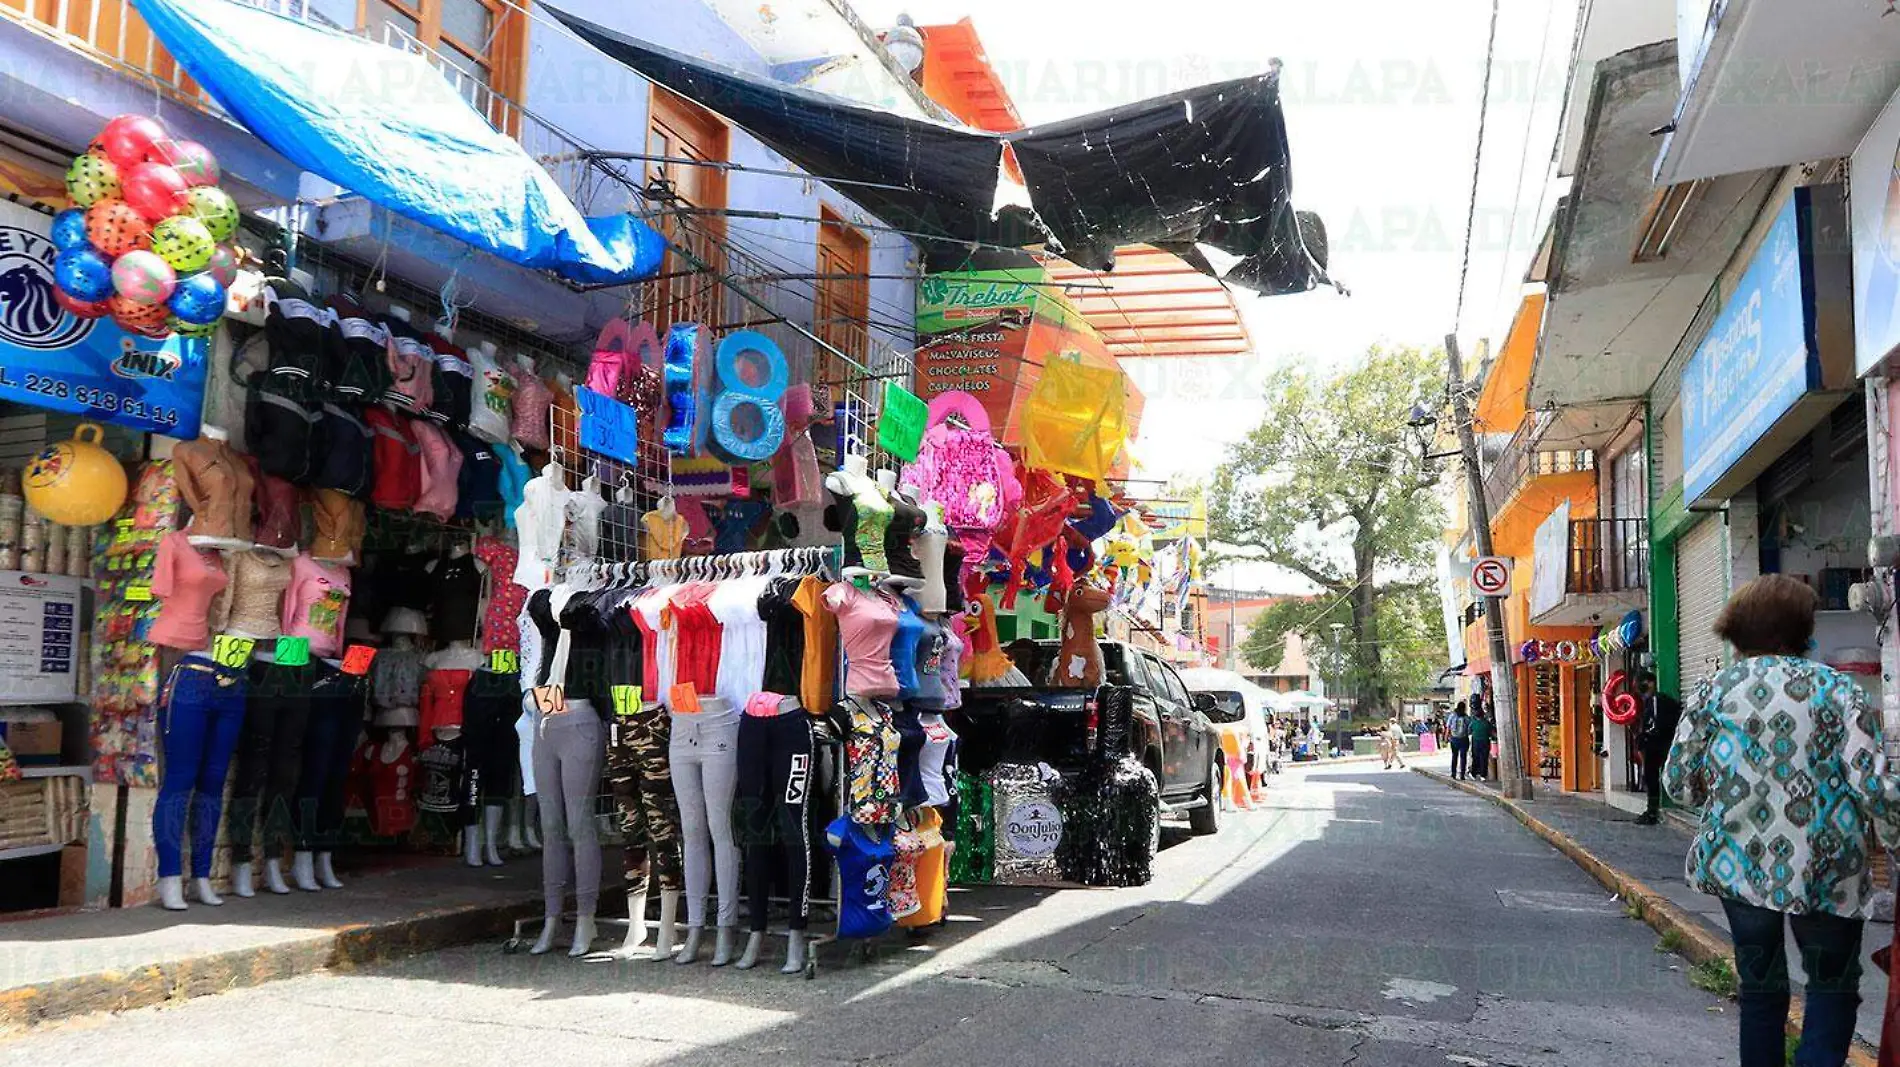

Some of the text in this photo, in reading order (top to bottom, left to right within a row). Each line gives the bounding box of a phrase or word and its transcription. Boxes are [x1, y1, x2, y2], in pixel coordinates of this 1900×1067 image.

[947, 283, 1028, 307] Trebol
[971, 332, 1005, 343] FIESTA
[929, 350, 1000, 360] MALVAVISCOS
[928, 366, 998, 376] CHOCOLATES
[25, 373, 69, 399] 228
[76, 387, 118, 411] 818
[122, 400, 148, 418] 61
[152, 406, 179, 425] 14
[787, 755, 808, 803] FILA
[1041, 833, 1059, 843] 70
